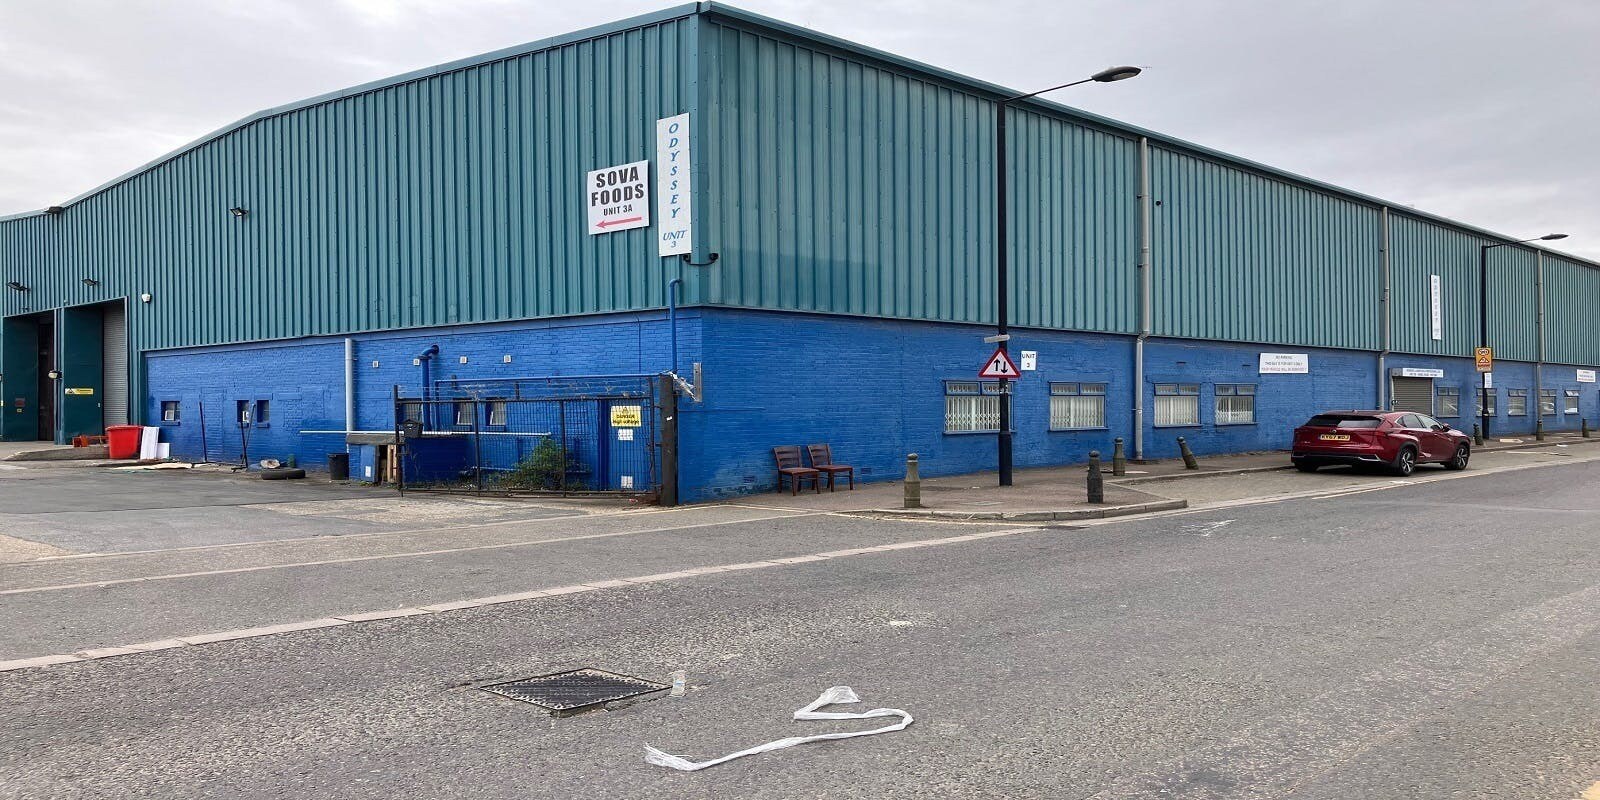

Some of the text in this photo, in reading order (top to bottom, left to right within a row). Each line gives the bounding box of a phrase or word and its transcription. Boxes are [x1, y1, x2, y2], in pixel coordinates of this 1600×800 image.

[596, 166, 639, 189] SOVA
[669, 122, 680, 219] ODYSSEY
[591, 183, 645, 207] FOODS
[603, 203, 633, 217] UNIT 3A
[663, 230, 687, 241] UNIT
